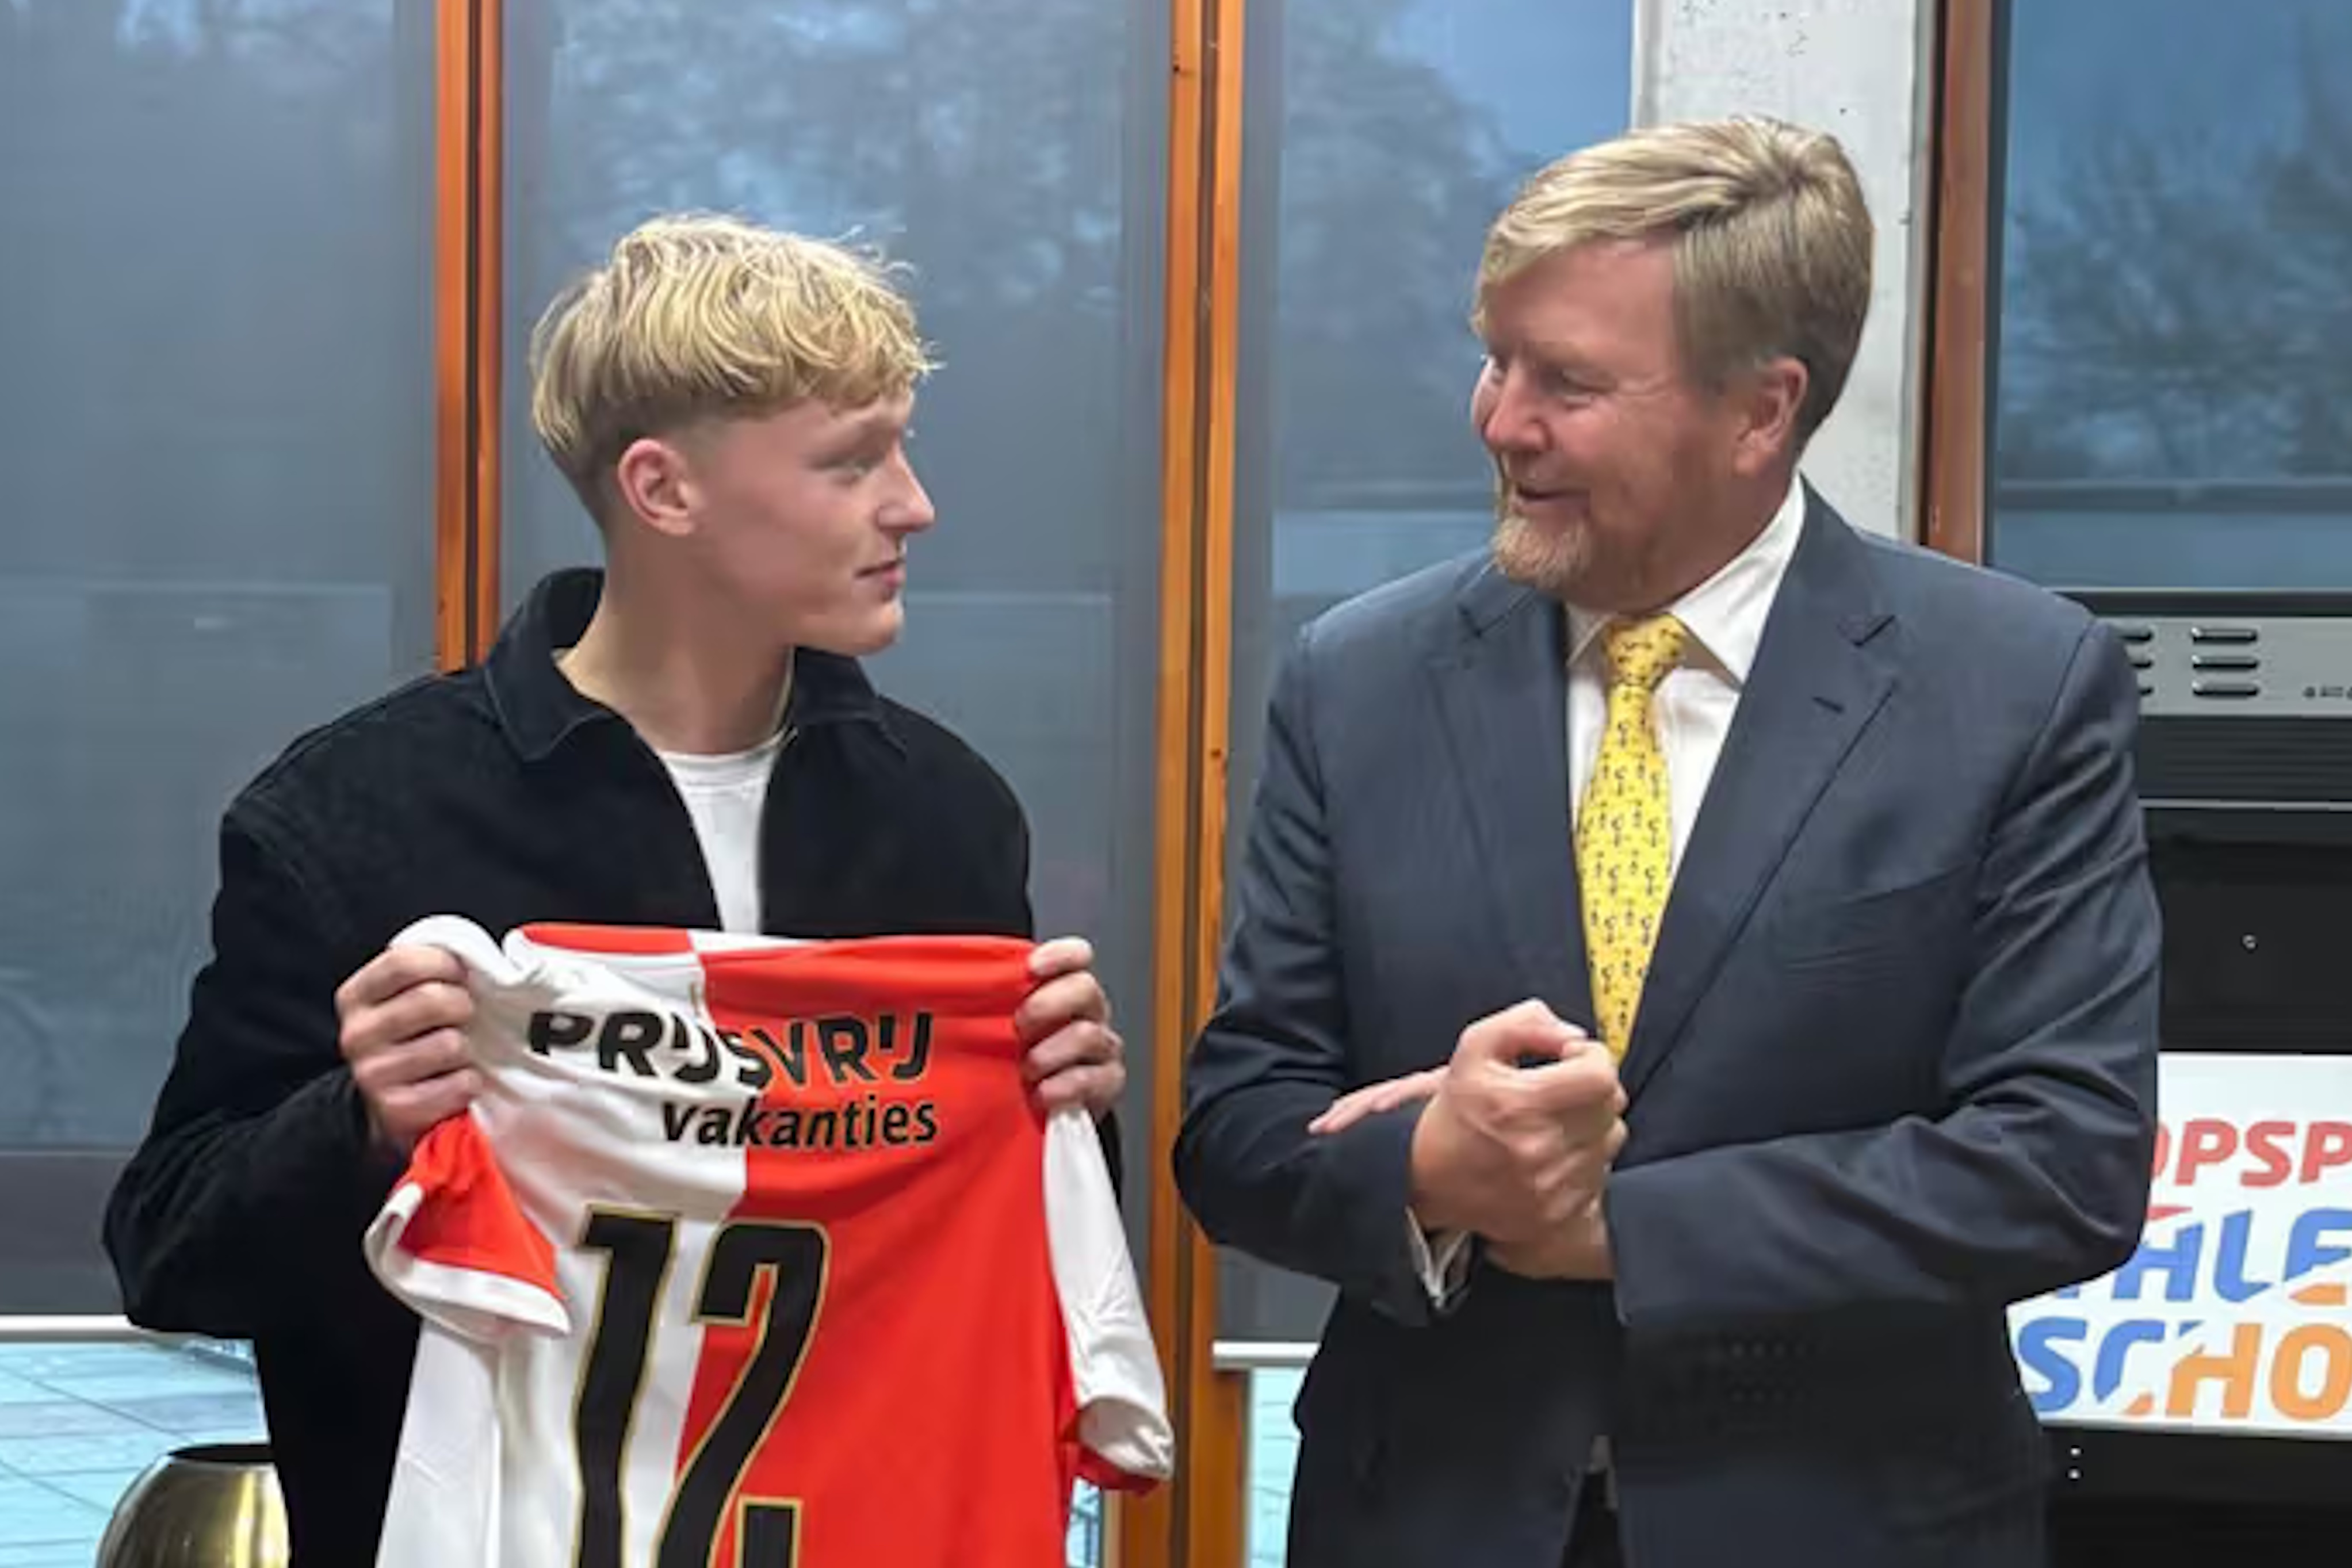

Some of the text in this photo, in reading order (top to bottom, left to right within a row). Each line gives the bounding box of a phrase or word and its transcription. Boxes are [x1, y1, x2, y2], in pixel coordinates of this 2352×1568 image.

[662, 1094, 938, 1148] vakanties
[2056, 1207, 2352, 1304] HLE
[569, 1203, 832, 1568] 12
[2018, 1317, 2352, 1421] SCHO
